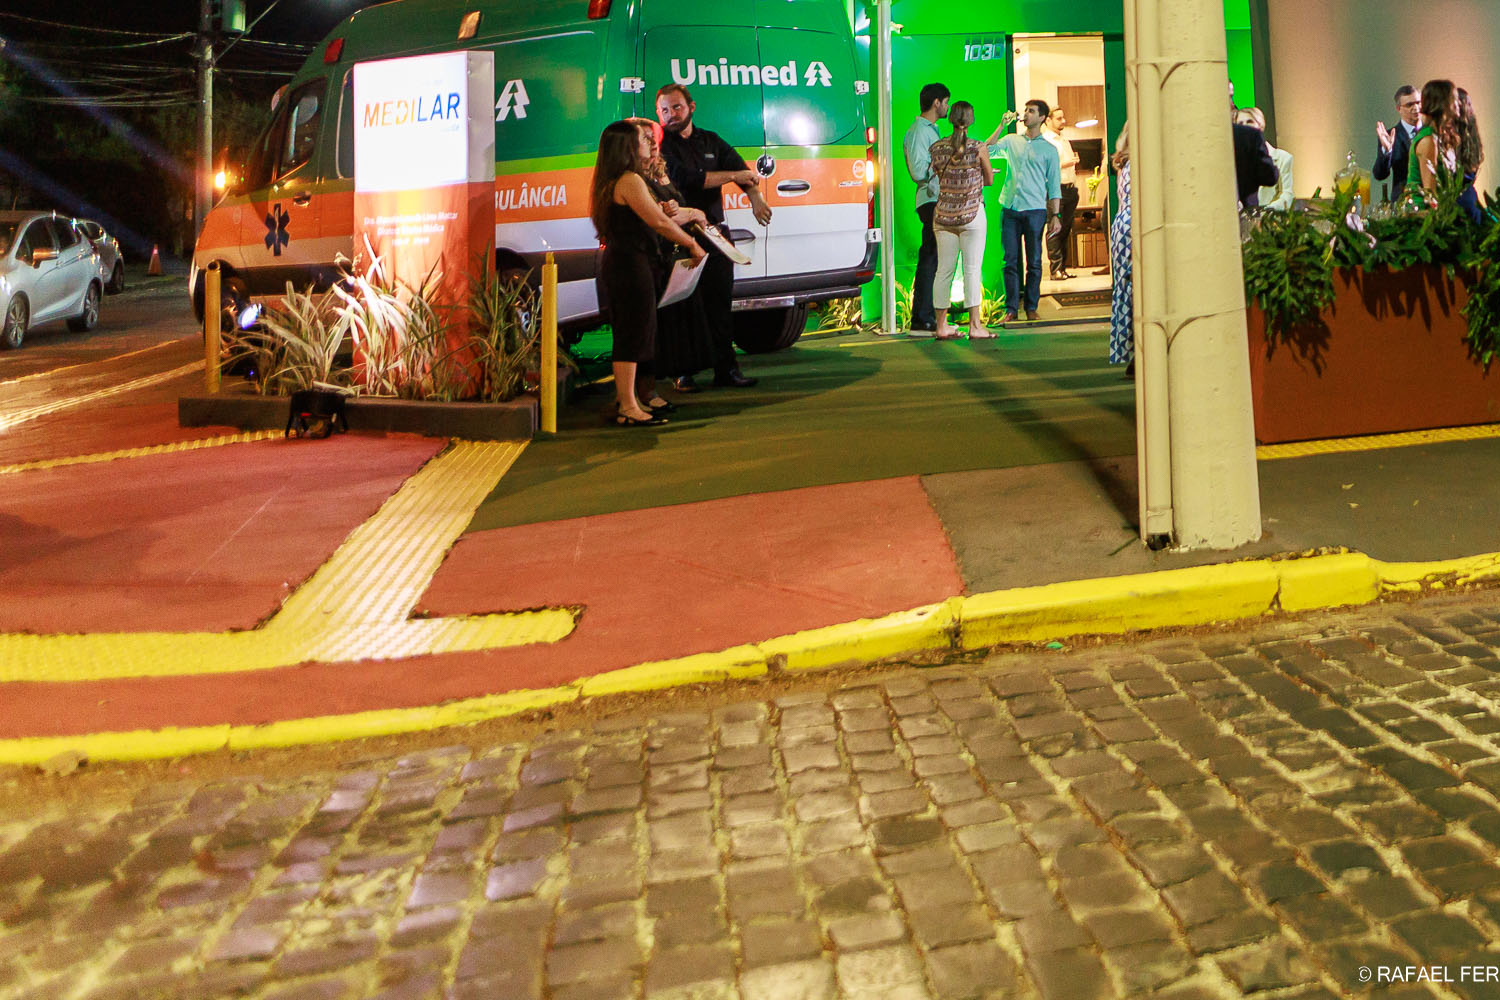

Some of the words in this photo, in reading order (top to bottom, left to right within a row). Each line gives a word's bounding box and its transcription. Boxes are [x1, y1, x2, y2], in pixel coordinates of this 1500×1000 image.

[964, 43, 1004, 62] 1030
[670, 57, 798, 86] Unimed
[363, 92, 461, 129] MEDILAR
